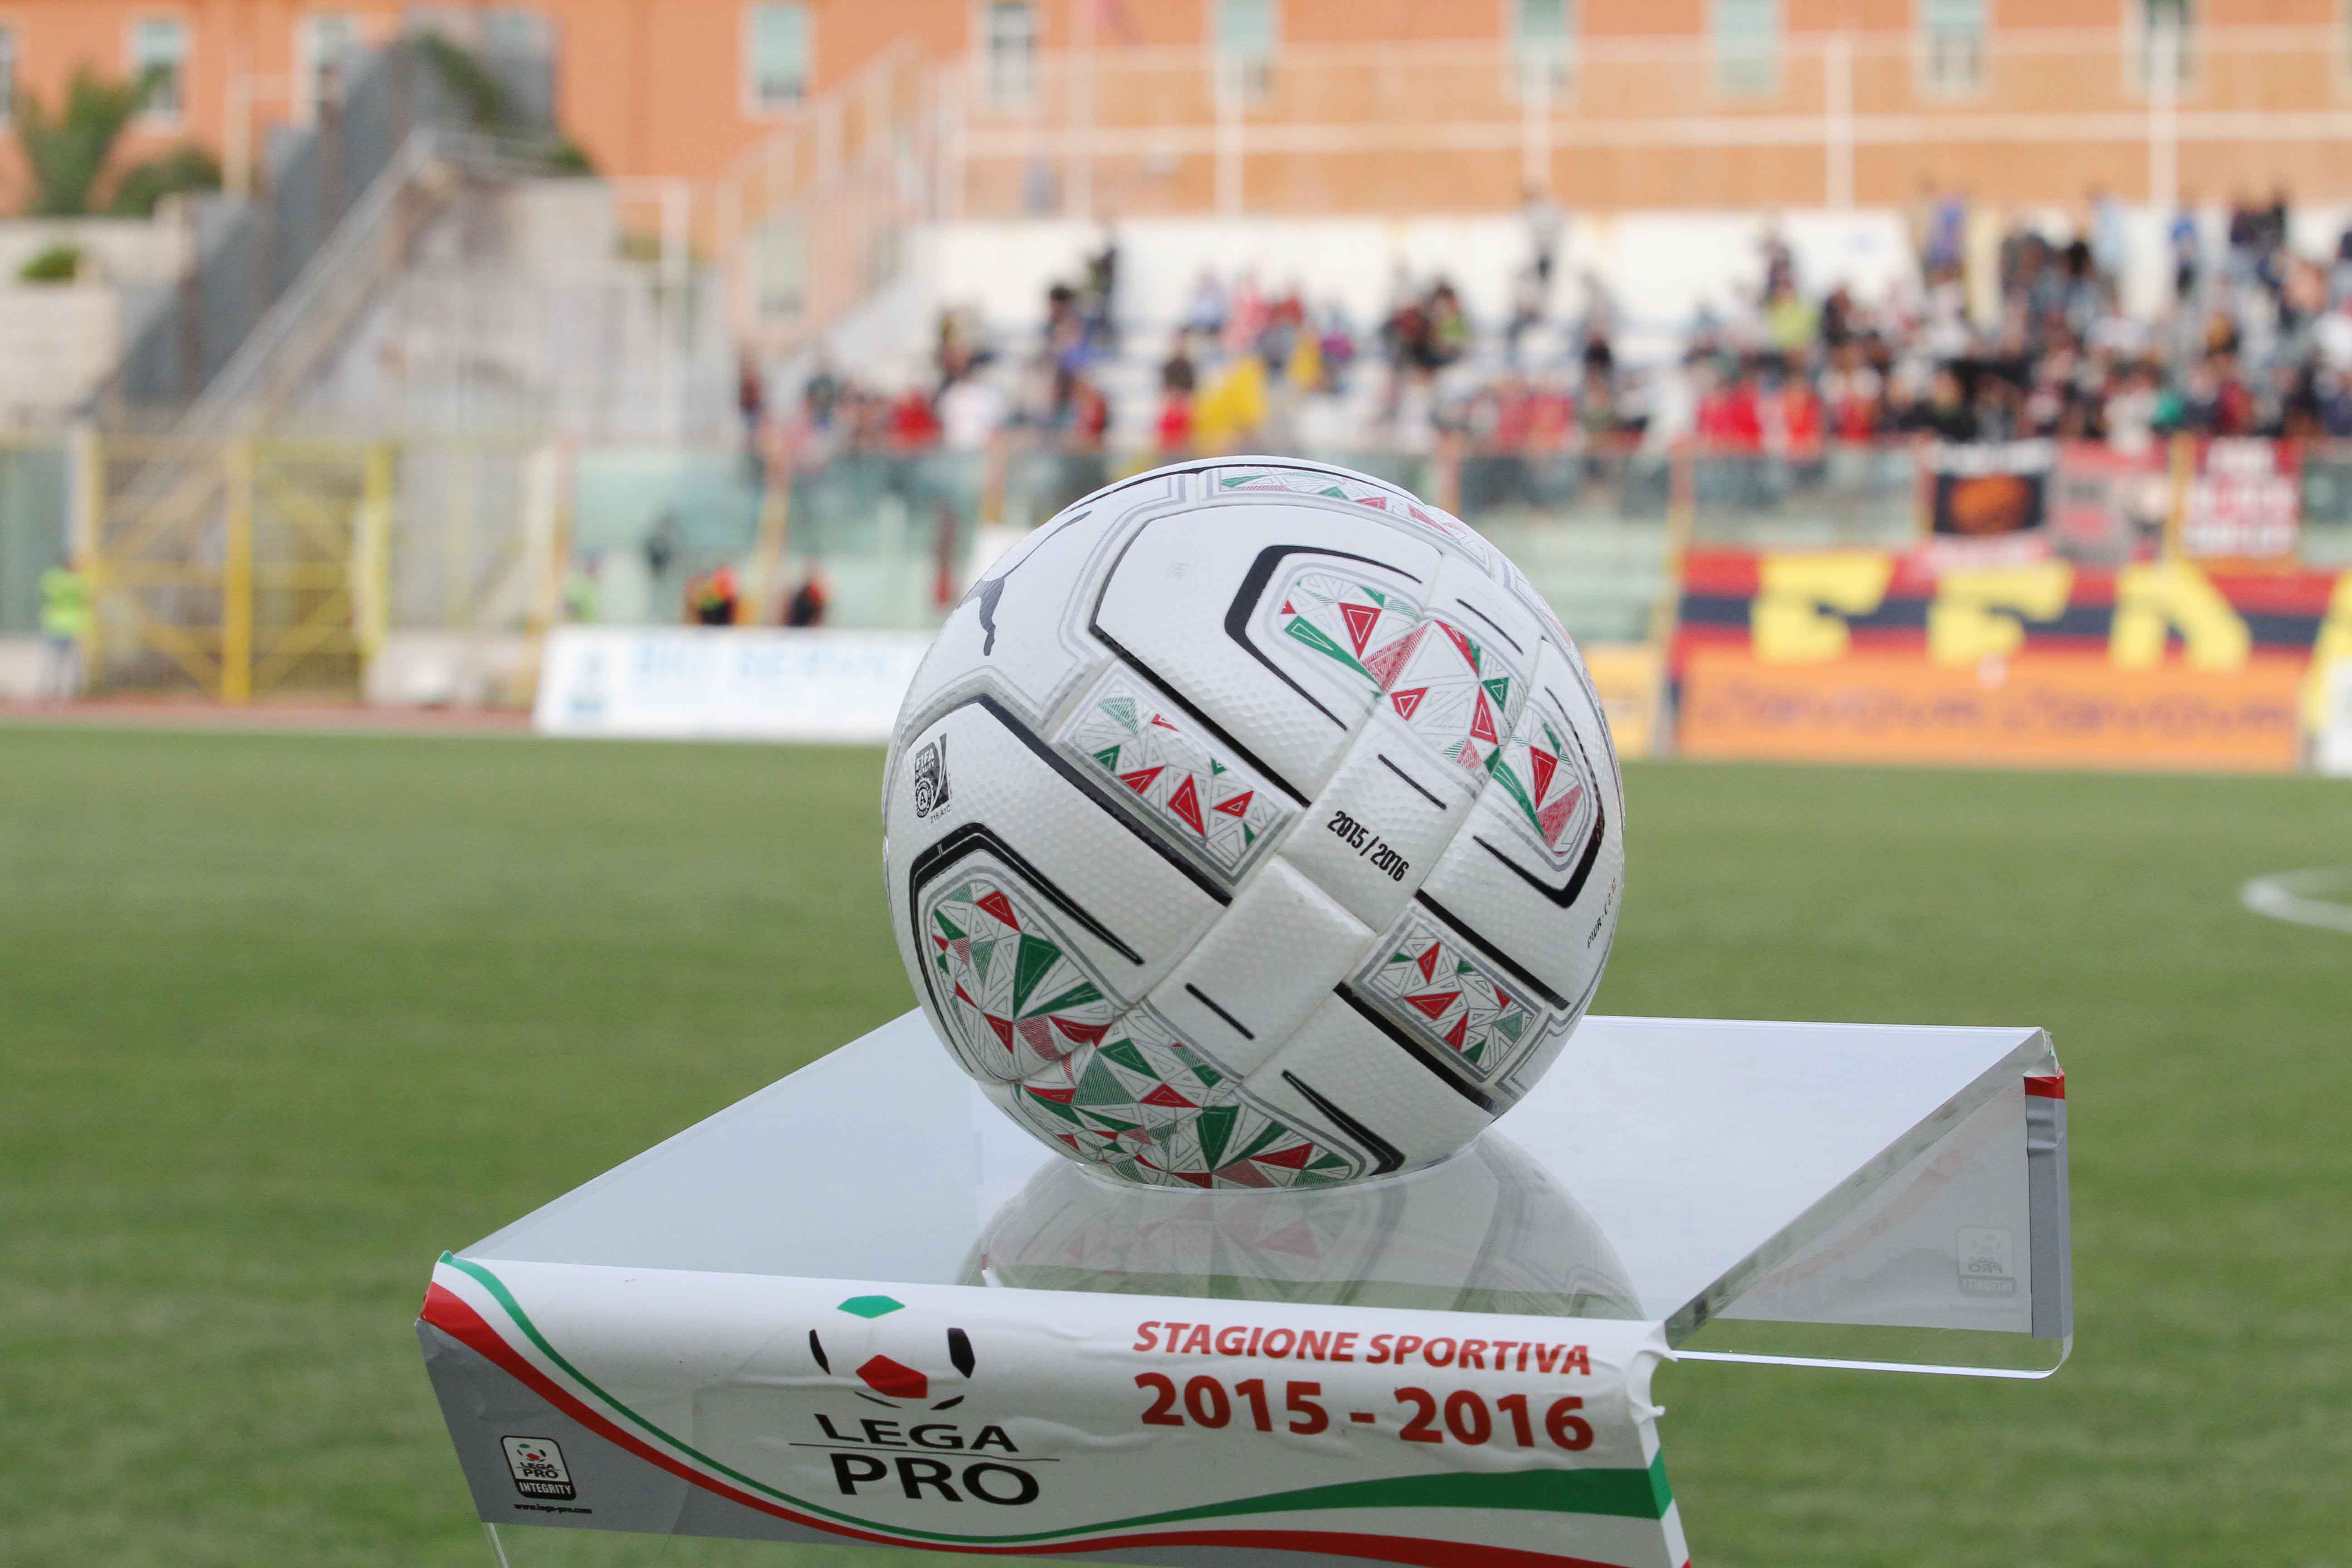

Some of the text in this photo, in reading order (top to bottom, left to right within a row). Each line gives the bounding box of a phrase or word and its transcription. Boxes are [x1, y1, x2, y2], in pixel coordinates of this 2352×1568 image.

[916, 748, 935, 770] FIFA
[1133, 1321, 1591, 1375] STAGIONE SPORTIVA
[1134, 1372, 1330, 1436] 2015
[1394, 1387, 1594, 1451] 2016
[813, 1413, 1019, 1452] LEGA
[519, 1482, 572, 1495] INTEGRITY
[523, 1469, 559, 1479] PRO
[830, 1453, 1039, 1505] PRO
